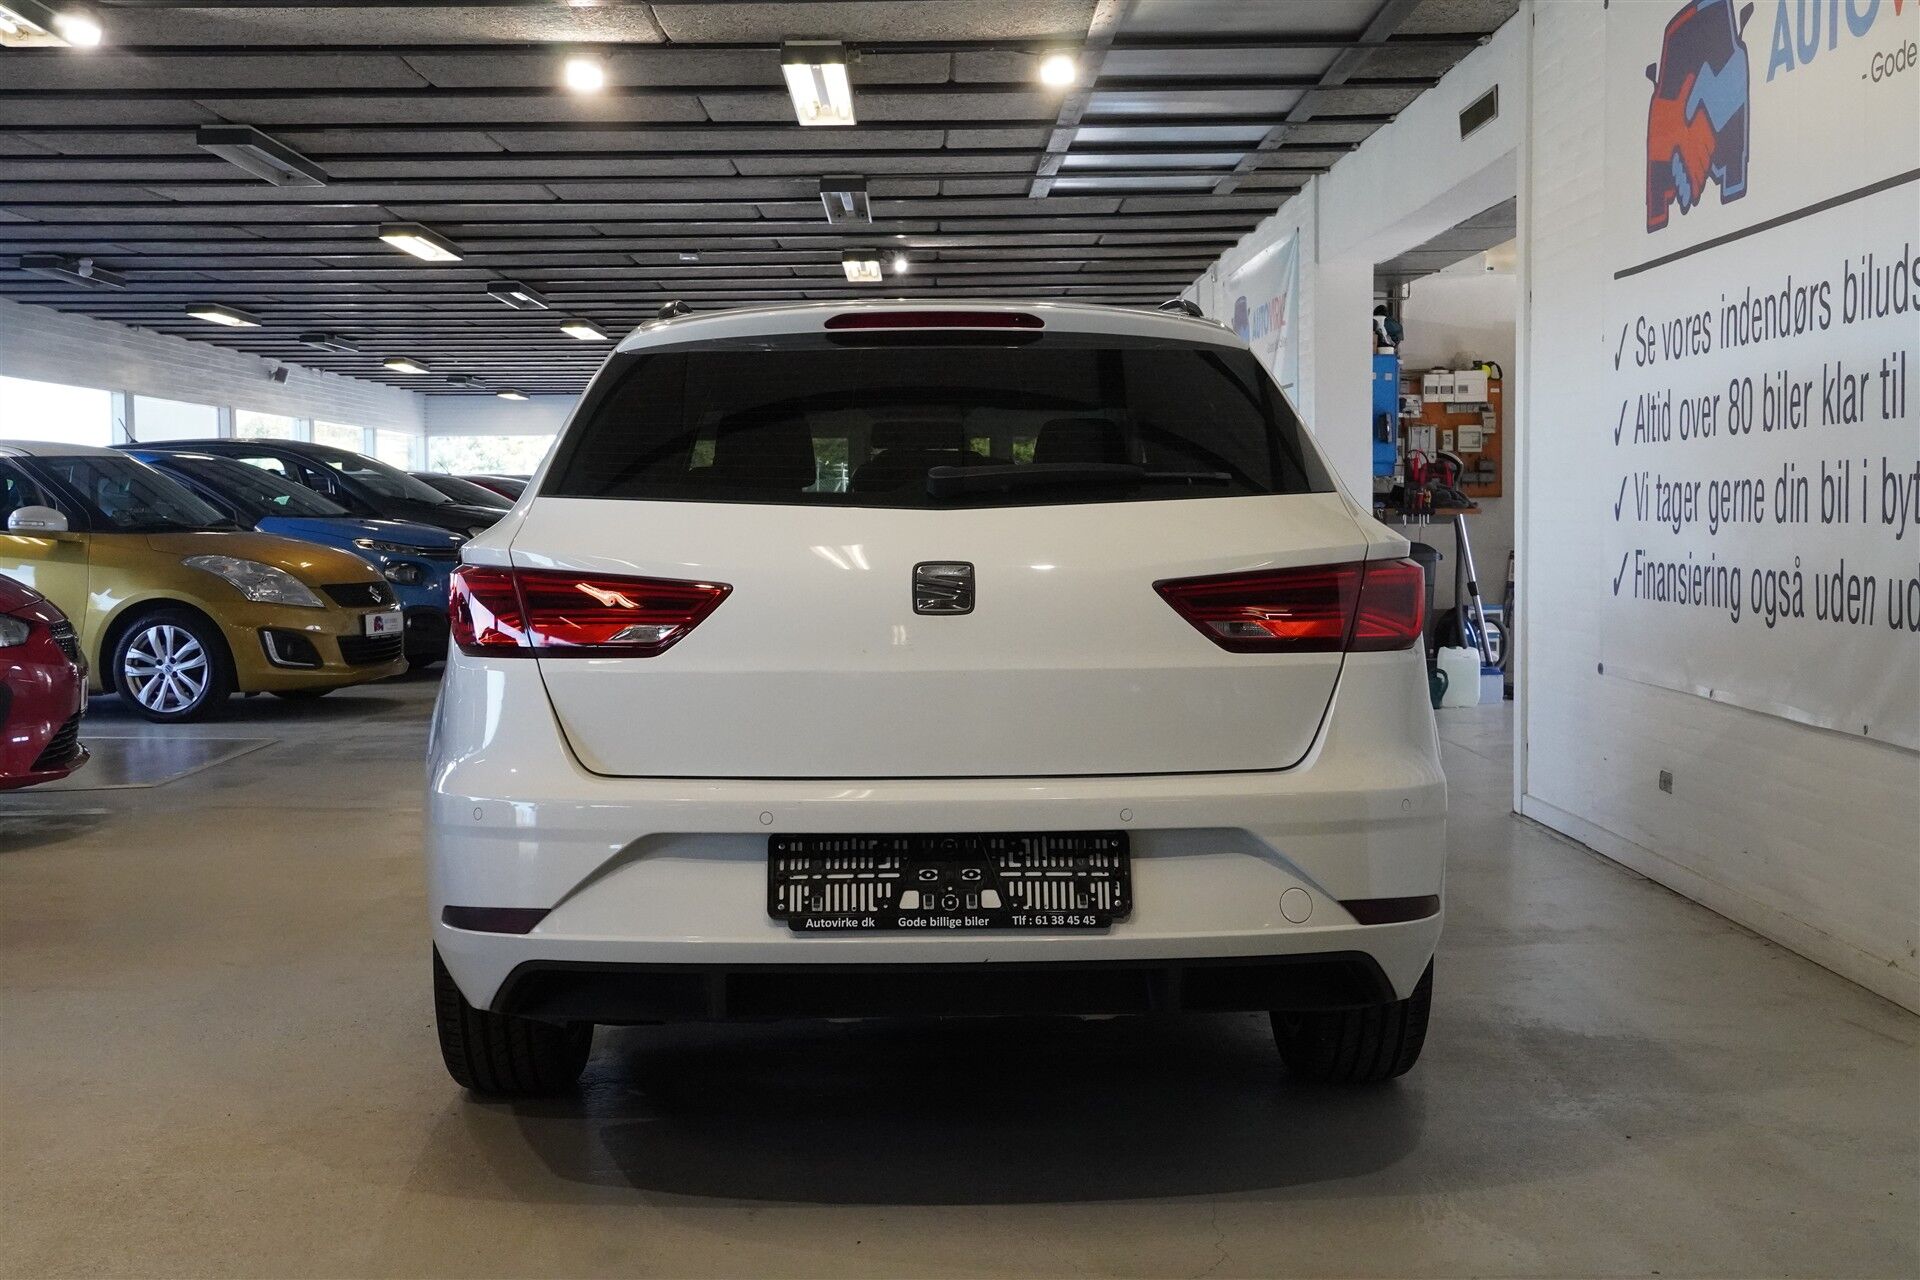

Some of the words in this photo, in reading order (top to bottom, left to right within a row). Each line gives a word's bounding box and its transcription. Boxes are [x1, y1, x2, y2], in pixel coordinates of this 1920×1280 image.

[1766, 0, 1903, 83] AUT
[1636, 316, 1656, 367] Se
[1662, 311, 1711, 360] vores
[1720, 275, 1832, 349] indendørs
[1634, 389, 1671, 444] Altid
[1679, 394, 1720, 440] over
[1728, 377, 1753, 435] 80
[1763, 370, 1812, 432] biler
[1822, 361, 1869, 426] klar
[1879, 350, 1905, 420] til
[1634, 471, 1649, 522] Vi
[1656, 474, 1701, 534] tager
[1708, 479, 1765, 535] gerne
[1774, 462, 1808, 524] din
[1821, 459, 1849, 524] bil
[1863, 458, 1868, 524] i
[1634, 549, 1741, 623] Finansiering
[1751, 555, 1804, 628] også
[1815, 558, 1876, 625] uden
[805, 917, 858, 928] Autovirke
[861, 917, 875, 928] dk
[898, 917, 927, 927] Gode
[930, 916, 962, 929] billige
[965, 916, 990, 926] biler
[1012, 915, 1027, 925] Tlf
[1035, 915, 1048, 925] 61
[1051, 915, 1064, 925] 38
[1067, 915, 1080, 925] 45
[1082, 915, 1096, 925] 45
